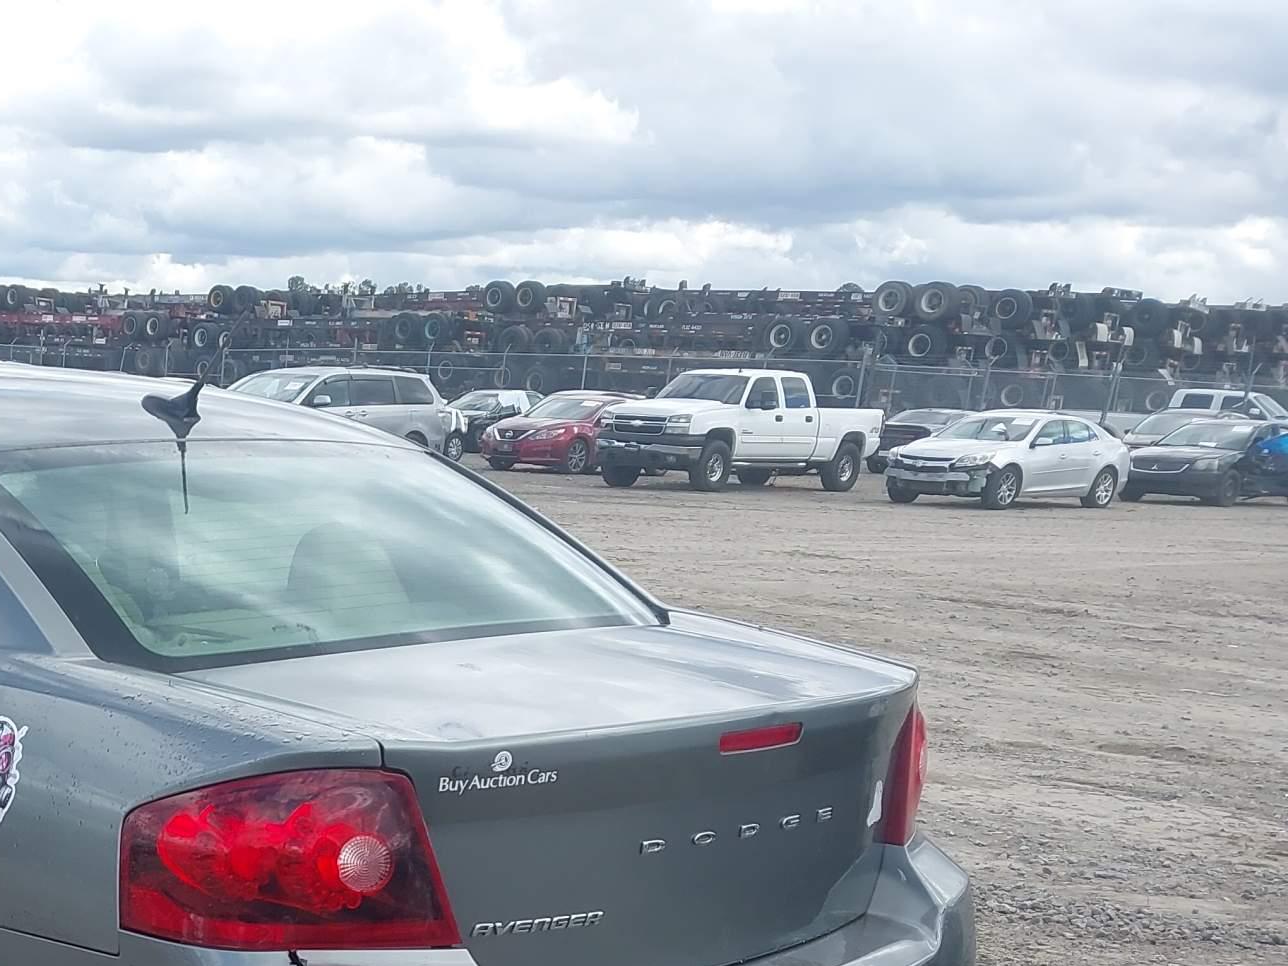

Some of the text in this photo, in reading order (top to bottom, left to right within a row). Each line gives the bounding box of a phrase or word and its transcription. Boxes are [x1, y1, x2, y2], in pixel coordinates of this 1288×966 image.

[439, 776, 469, 795] Buy
[468, 774, 525, 790] Auction
[527, 769, 558, 784] Cars
[640, 806, 833, 854] DODGE
[471, 909, 605, 937] AVENGER
